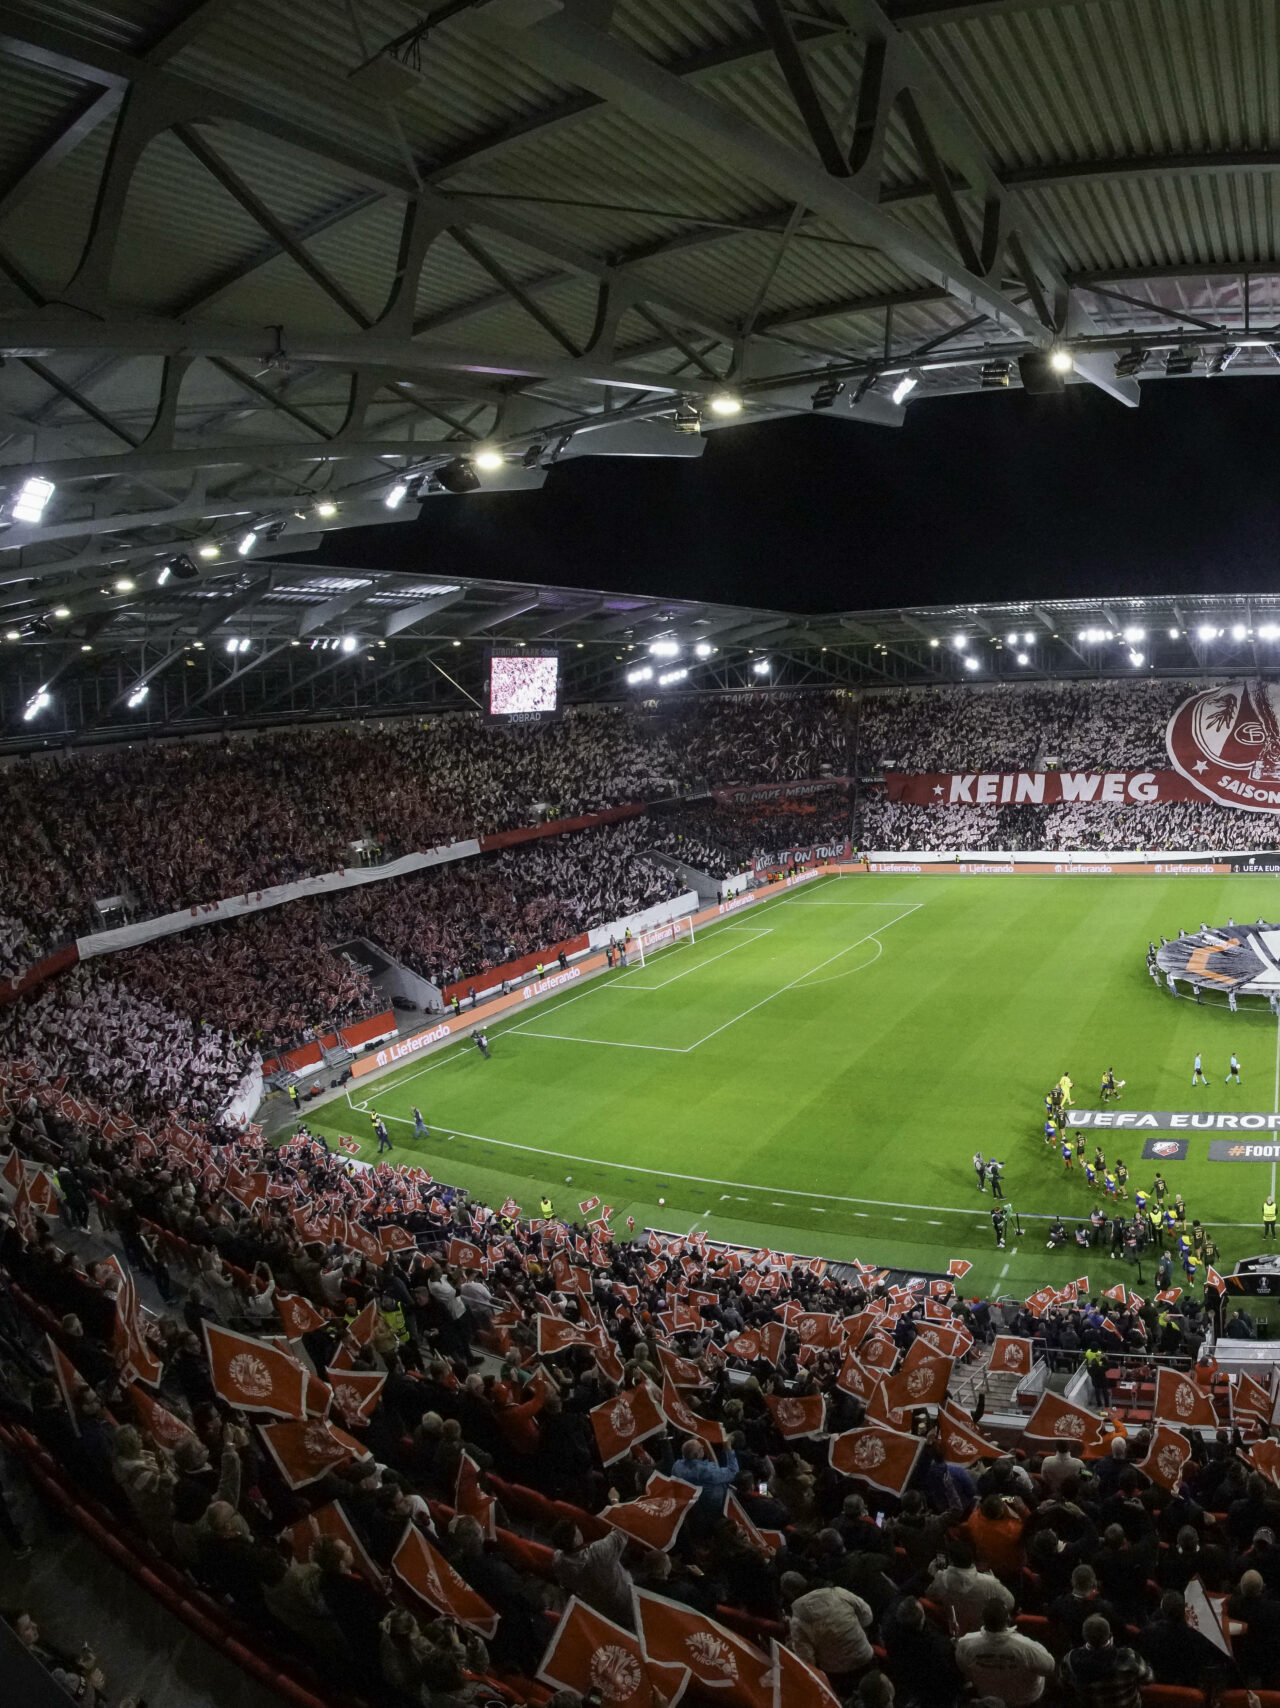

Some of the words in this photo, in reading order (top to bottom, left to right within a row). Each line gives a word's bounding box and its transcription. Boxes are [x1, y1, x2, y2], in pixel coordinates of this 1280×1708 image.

[508, 713, 541, 723] JOBRAD
[950, 773, 1046, 803] KEIN
[1059, 773, 1159, 802] WEG
[751, 789, 781, 801] MAKE
[794, 851, 812, 863] ON
[815, 844, 844, 858] TOUR
[879, 863, 921, 873] Lieferando
[969, 863, 1014, 873] Lieferando
[1065, 863, 1112, 873] Lieferando
[1165, 864, 1214, 874] Lieferando
[533, 966, 580, 994] Lieferando
[390, 1023, 450, 1060] Lieferando
[1067, 1113, 1159, 1127] UEFA
